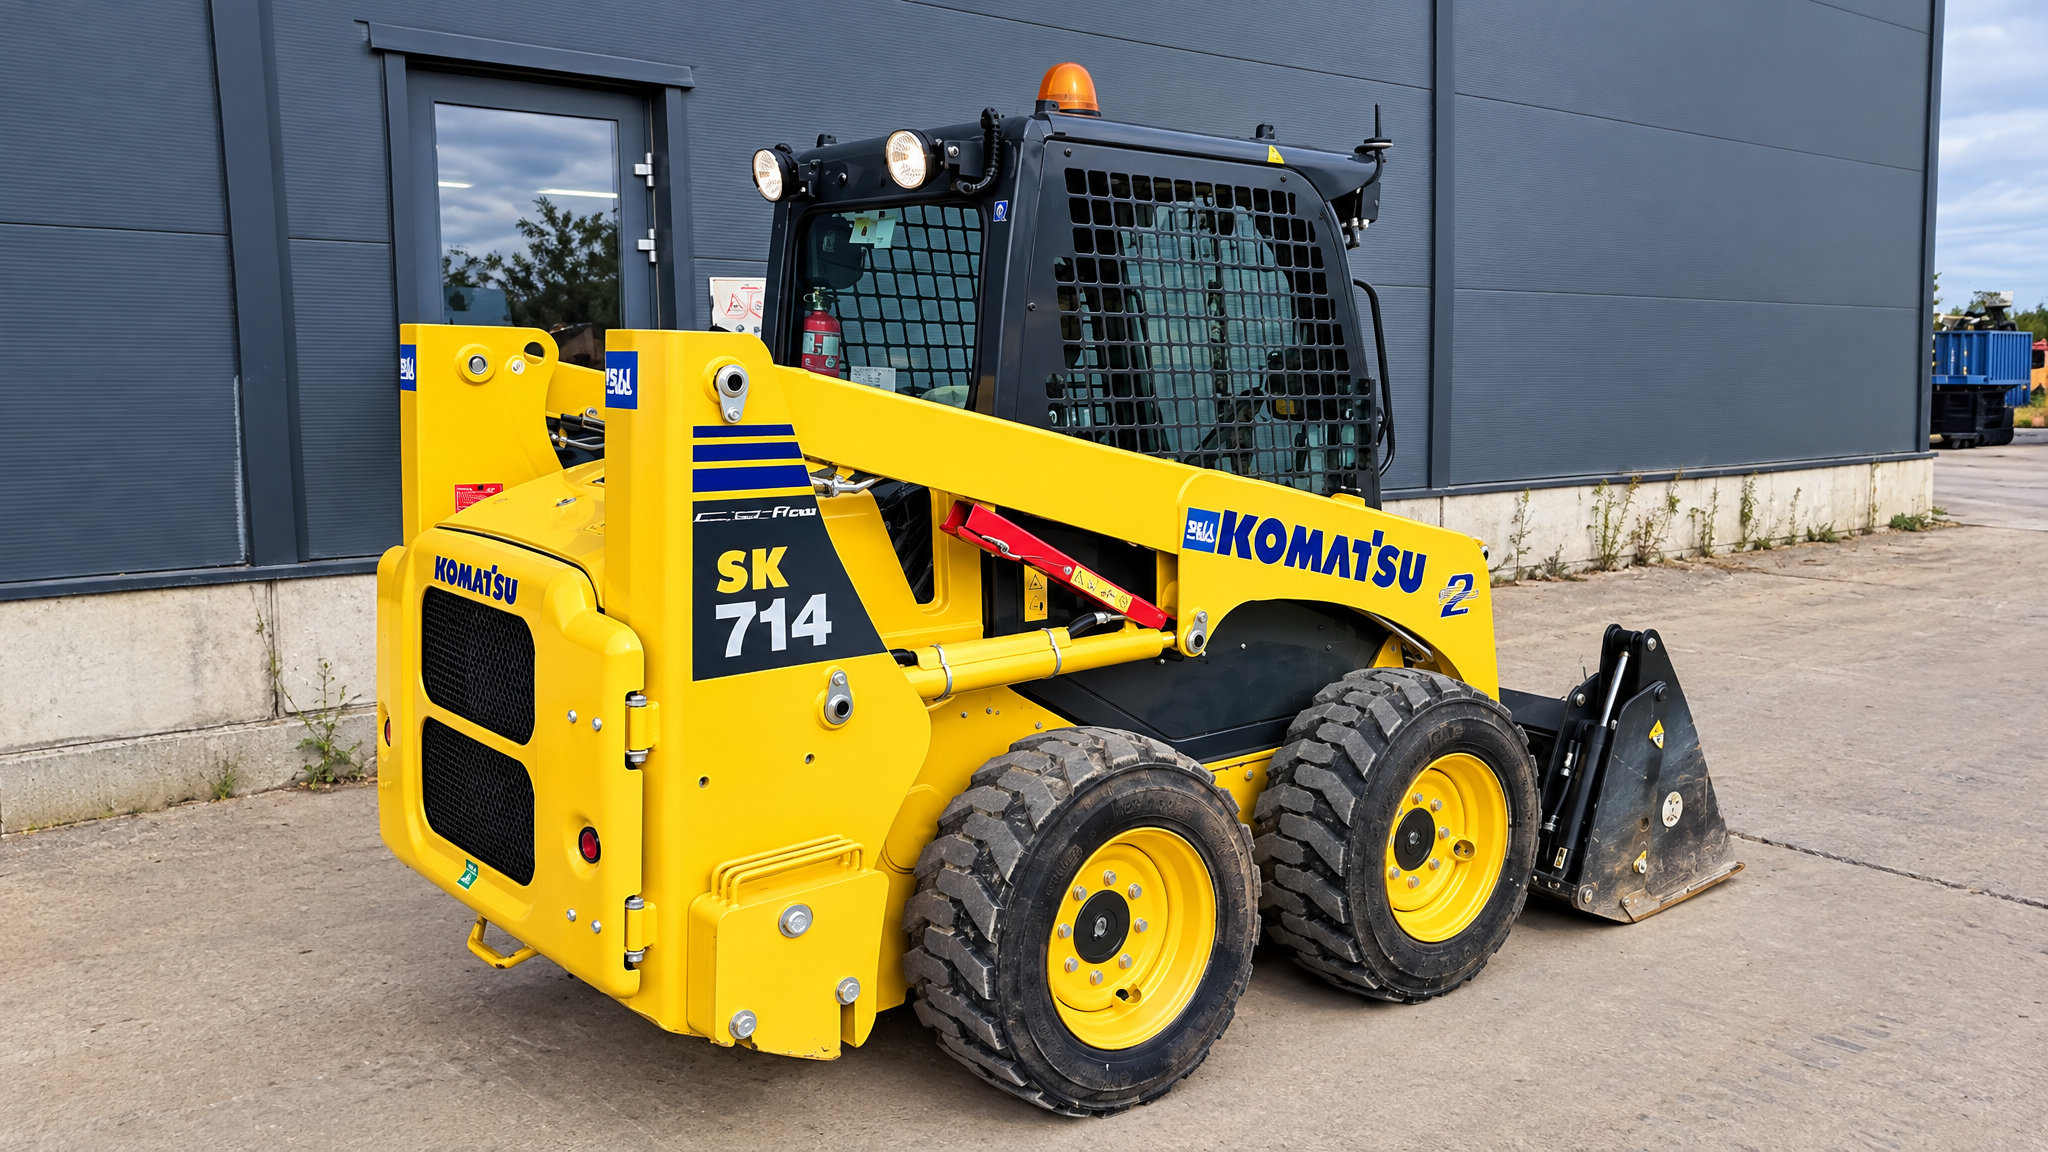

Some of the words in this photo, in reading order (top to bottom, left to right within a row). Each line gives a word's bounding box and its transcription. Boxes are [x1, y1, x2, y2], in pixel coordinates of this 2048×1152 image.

[434, 555, 518, 605] KOMATSU
[716, 546, 789, 594] SK
[1217, 509, 1427, 594] KOMATSU
[715, 593, 832, 658] 714
